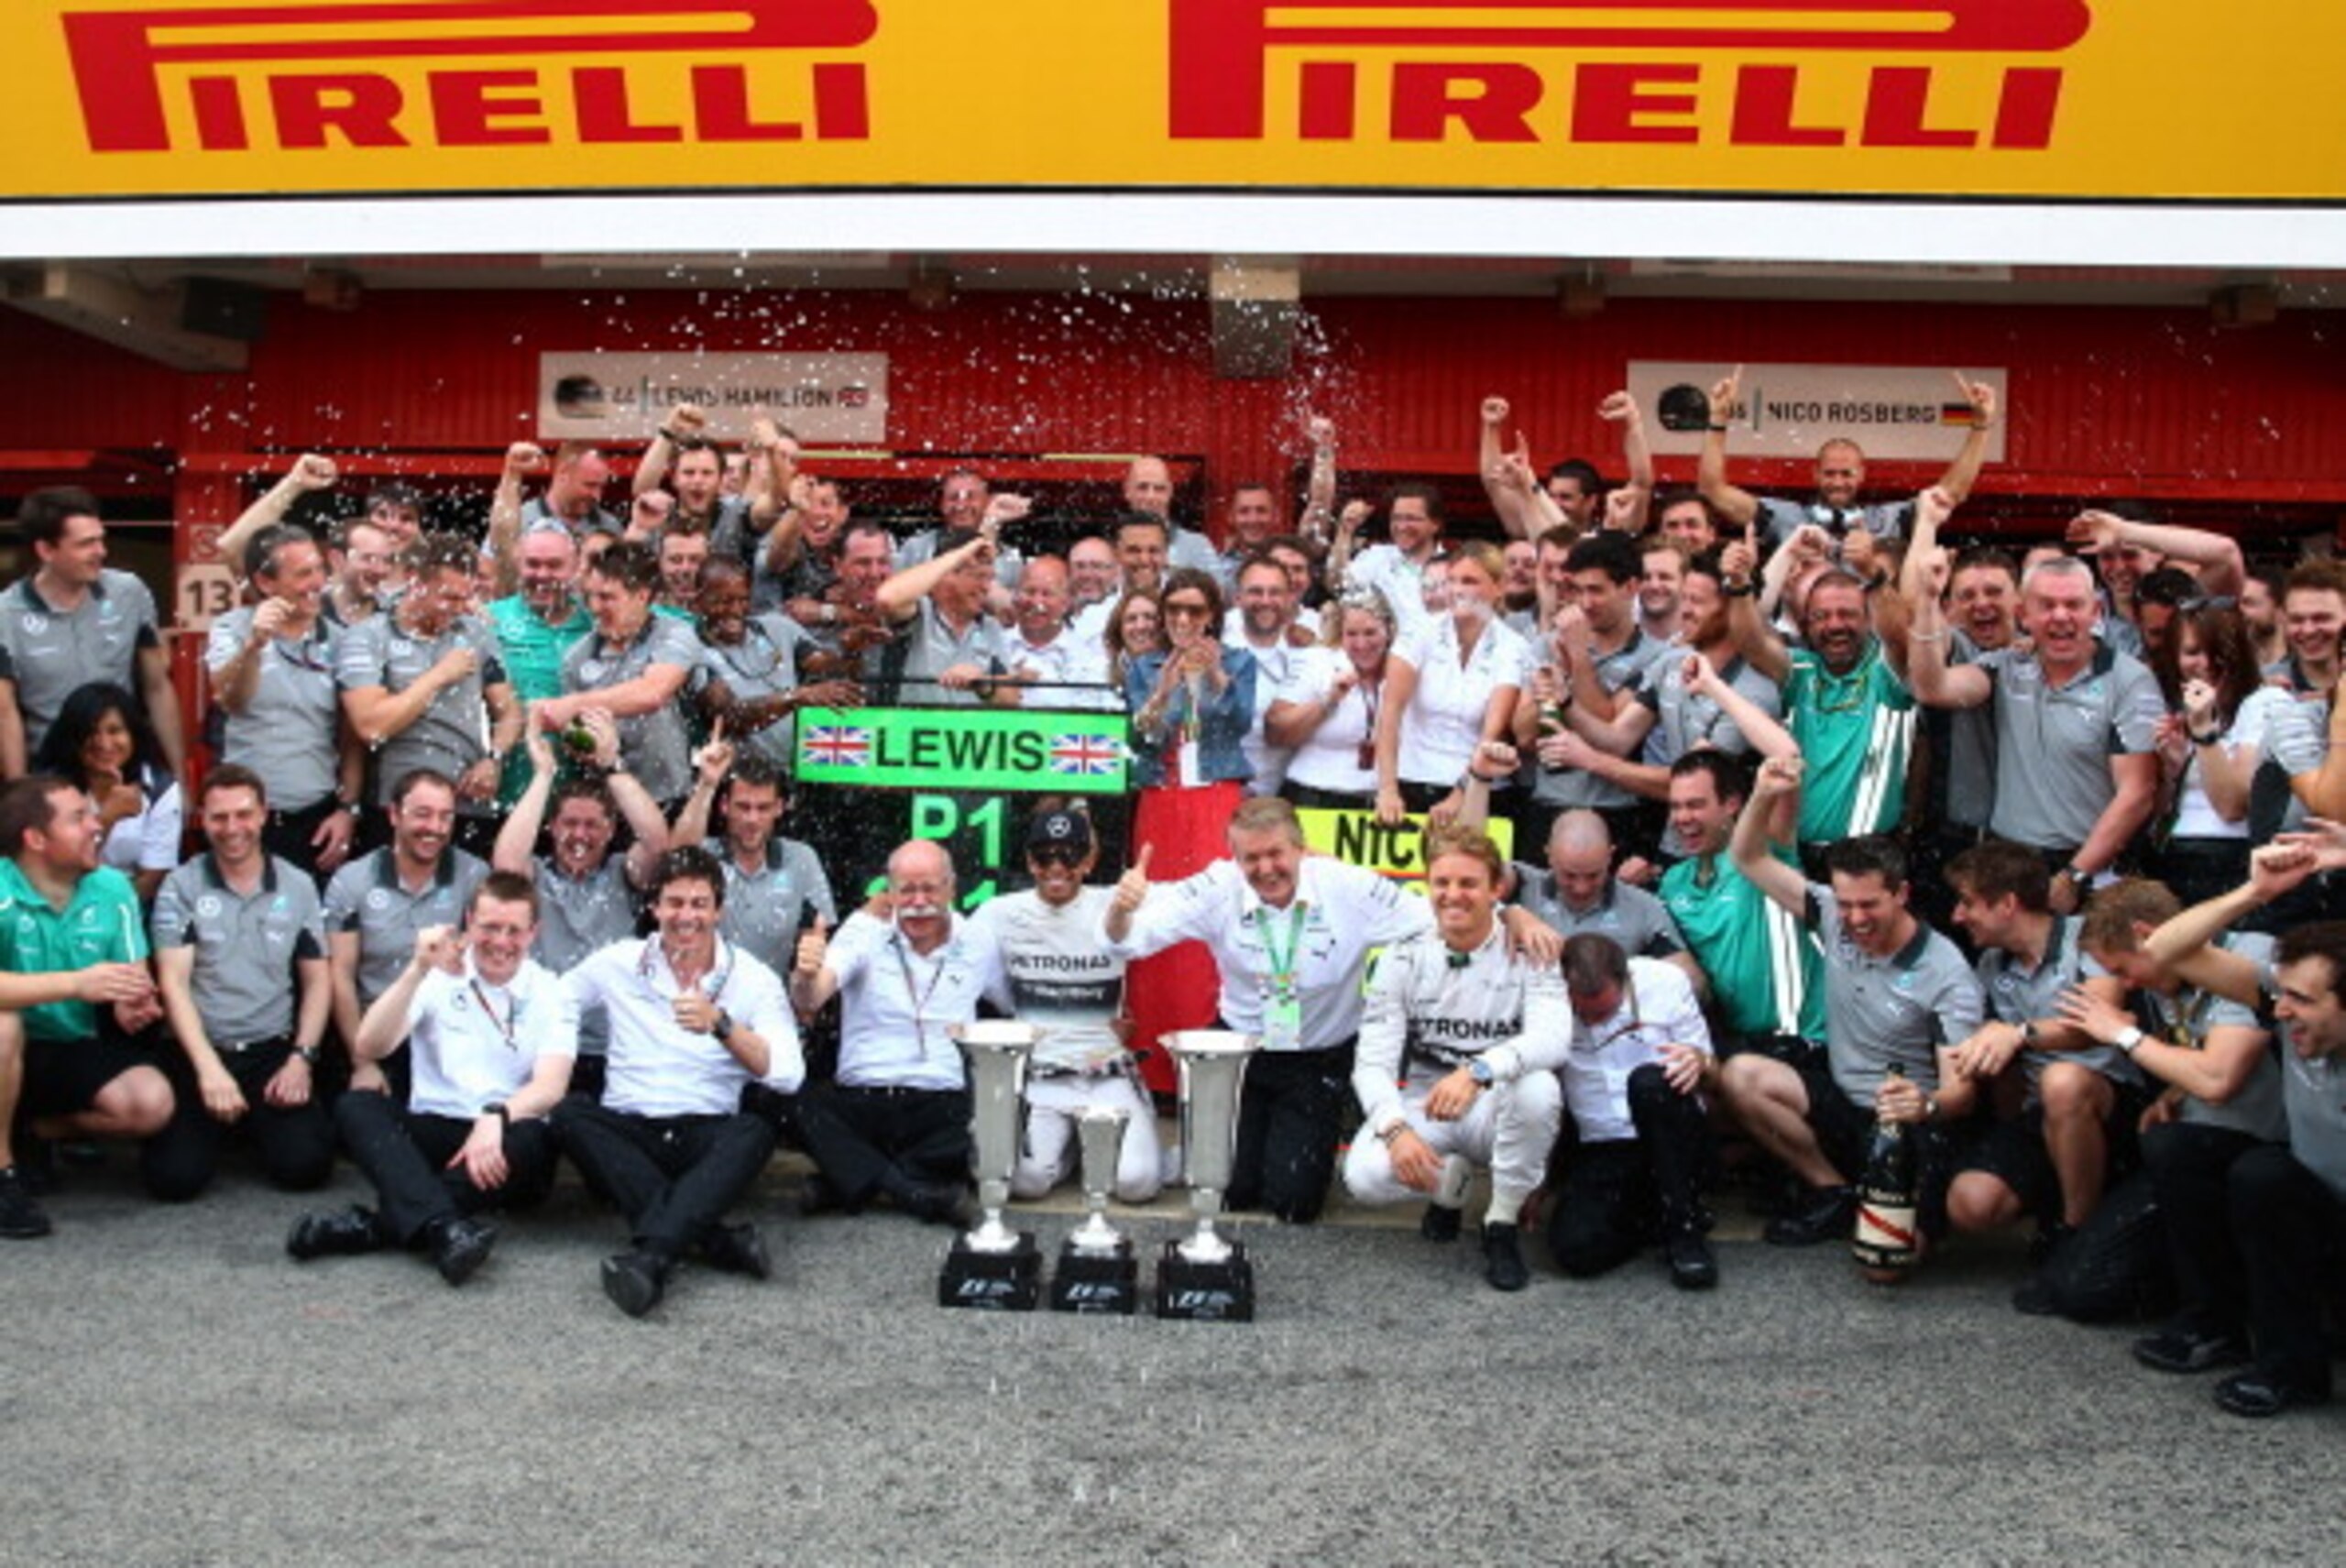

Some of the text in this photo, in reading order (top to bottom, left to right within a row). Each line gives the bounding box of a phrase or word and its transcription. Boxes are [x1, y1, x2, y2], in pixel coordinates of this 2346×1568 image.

[60, 0, 878, 152] PIRELLI
[1168, 0, 2091, 149] PIRELLI
[652, 385, 719, 406] LEWIS
[727, 386, 831, 408] HAMILTON
[1768, 401, 1822, 422] NICO
[1827, 401, 1936, 423] ROSBERG
[186, 579, 233, 616] 13
[875, 729, 1044, 772] LEWIS
[913, 795, 1003, 867] P1
[1334, 813, 1429, 867] NIC
